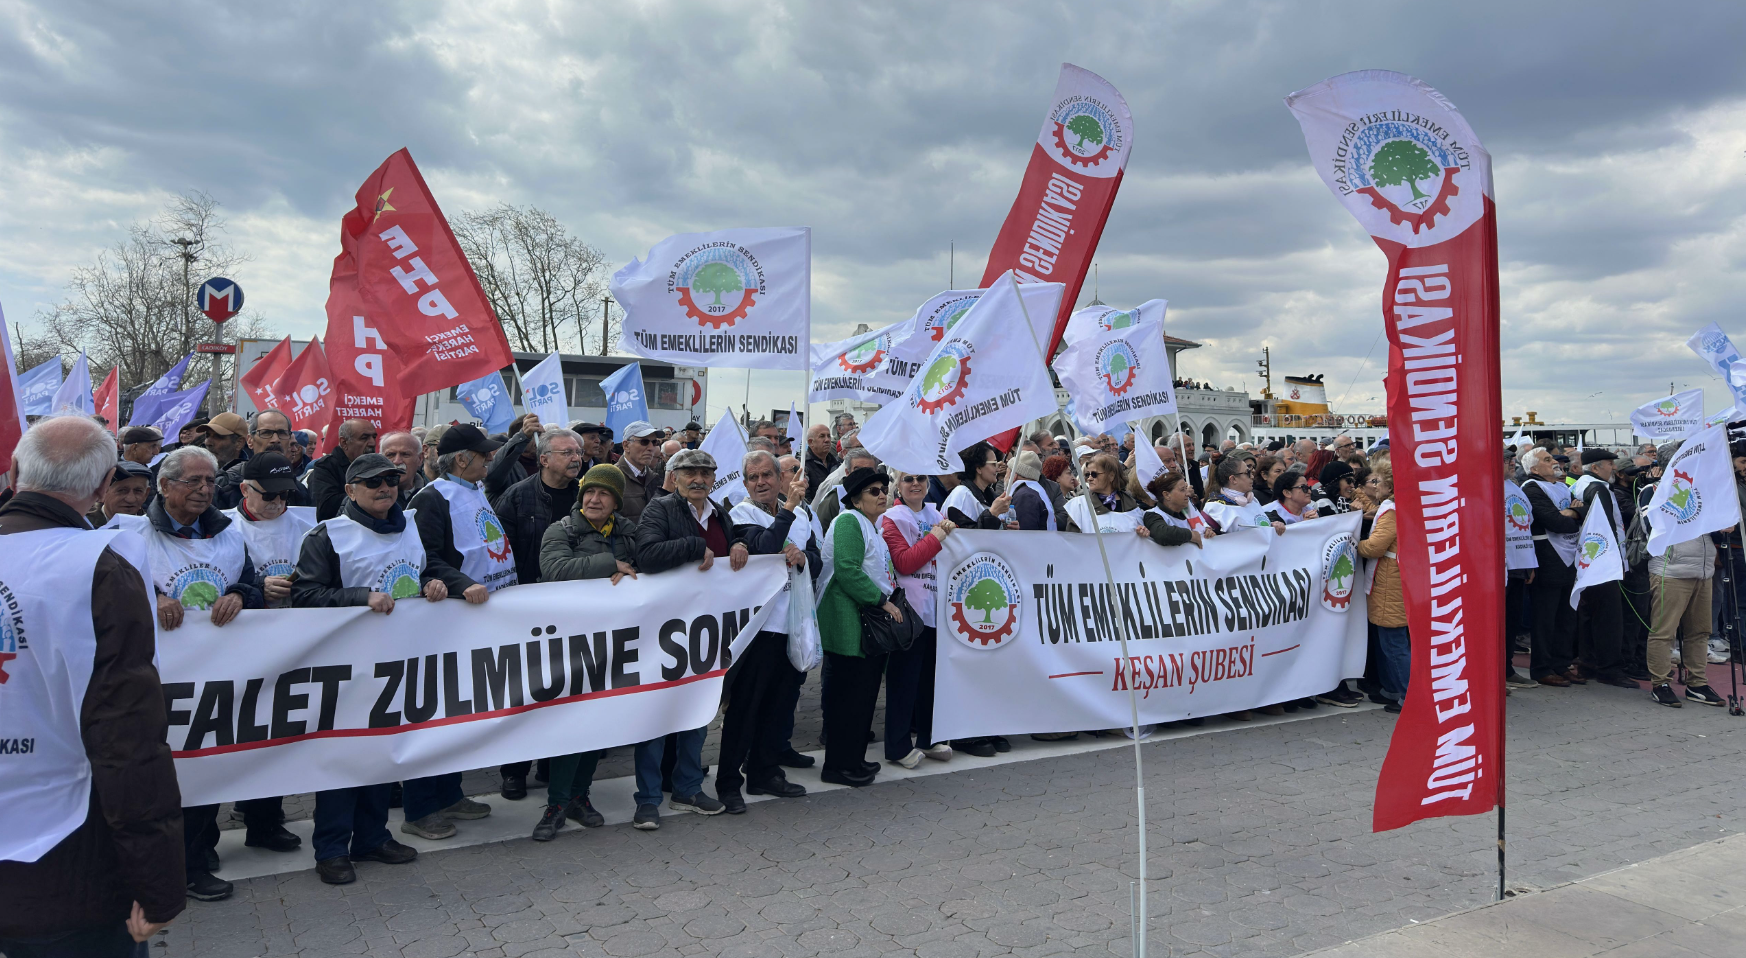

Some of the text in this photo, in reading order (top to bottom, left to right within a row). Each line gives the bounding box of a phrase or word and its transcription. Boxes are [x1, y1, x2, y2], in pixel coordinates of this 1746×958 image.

[667, 241, 766, 295] TÜM EMEKLİLERİN SENDİKASI
[634, 329, 798, 354] TÜM EMEKLİLERİN SENDİKASI
[1131, 390, 1170, 410] SENDİKASI
[1033, 563, 1081, 645] TÜM
[1215, 554, 1313, 633] SENDİKASI
[161, 664, 352, 751] FALET
[368, 624, 641, 729] ZULMÜNE
[1111, 635, 1255, 700] KEŞAN ŞUBESİ
